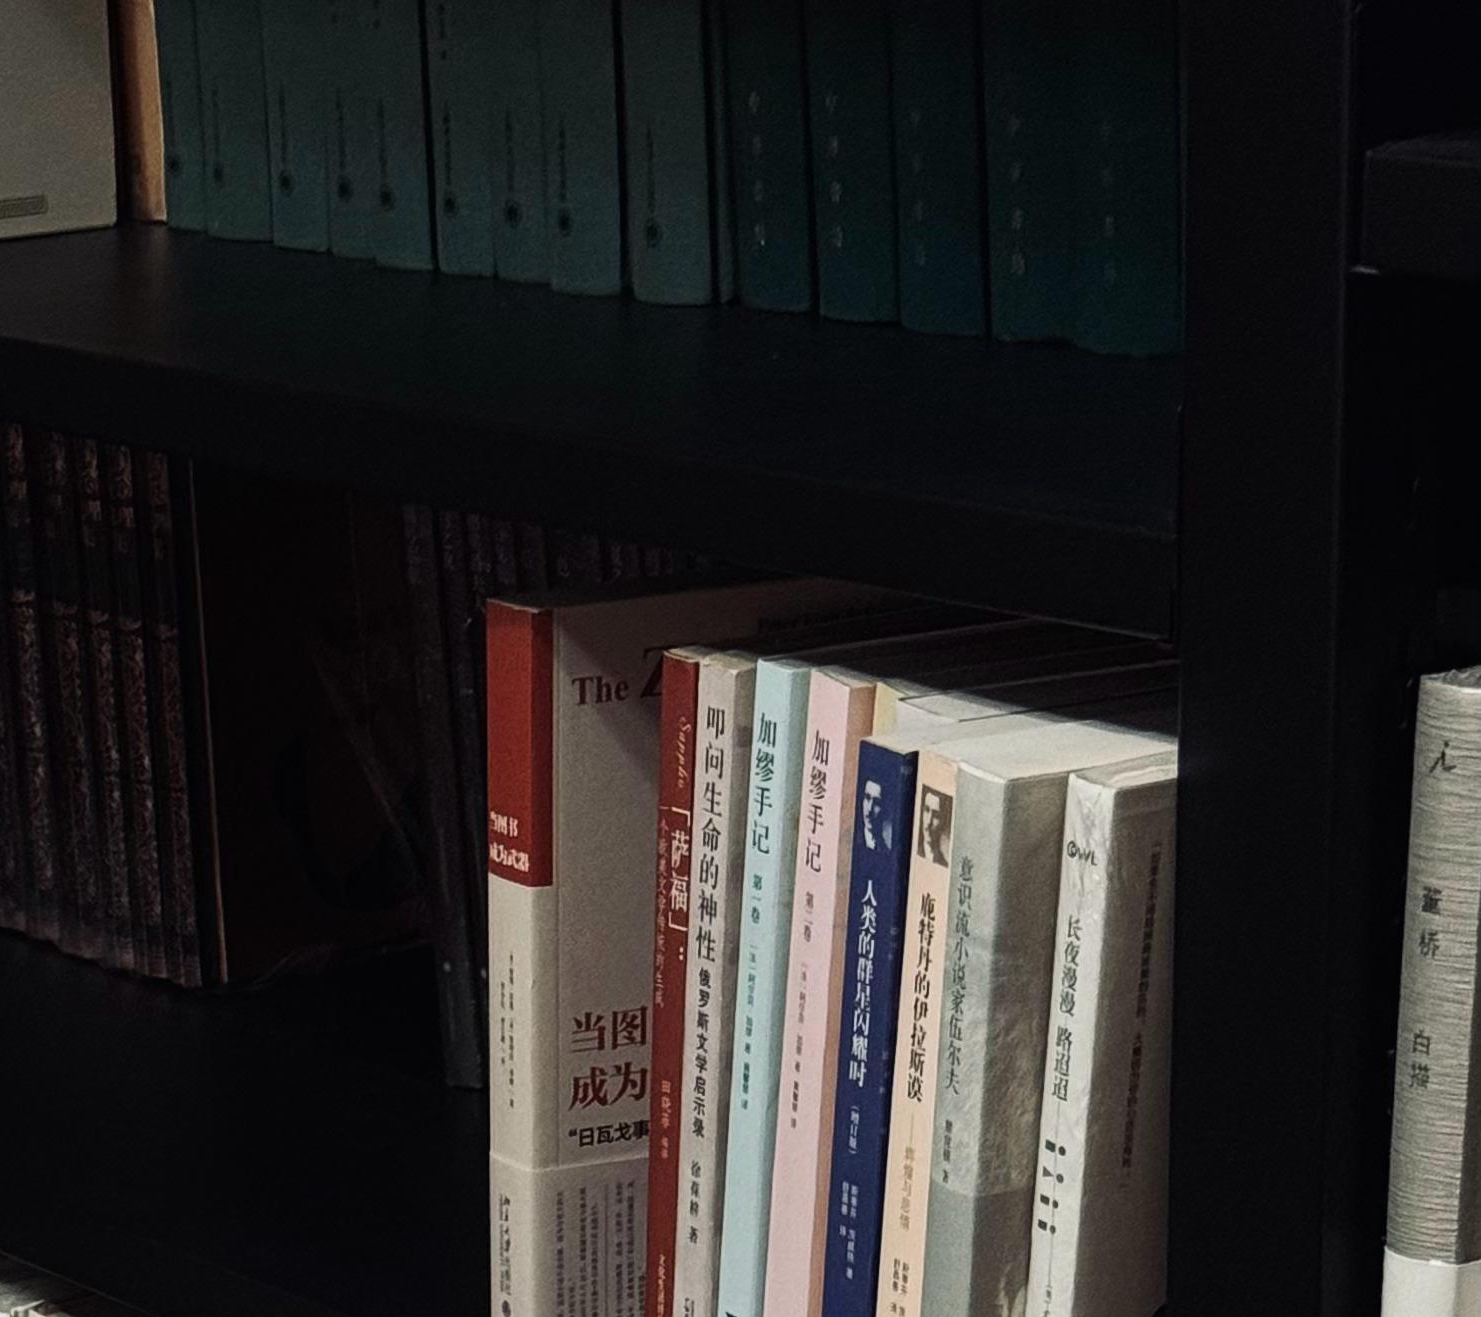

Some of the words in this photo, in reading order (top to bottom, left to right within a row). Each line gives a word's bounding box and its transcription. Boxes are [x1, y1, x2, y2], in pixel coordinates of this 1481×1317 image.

[571, 674, 630, 706] The
[695, 705, 726, 963] 叩问生命的神性
[753, 712, 778, 856] 加缪手记
[805, 729, 831, 874] 加缪手记
[570, 1005, 648, 1055] 当图
[848, 879, 877, 1089] 人类的群星闪耀时
[905, 892, 937, 1104] 鹿特丹的伊拉斯谟
[945, 855, 974, 1097] 意识流小说家伍尔夫
[1058, 914, 1082, 1017] 长夜漫漫
[568, 1061, 649, 1112] 成为
[690, 966, 712, 1140] 俄罗斯文学启示录
